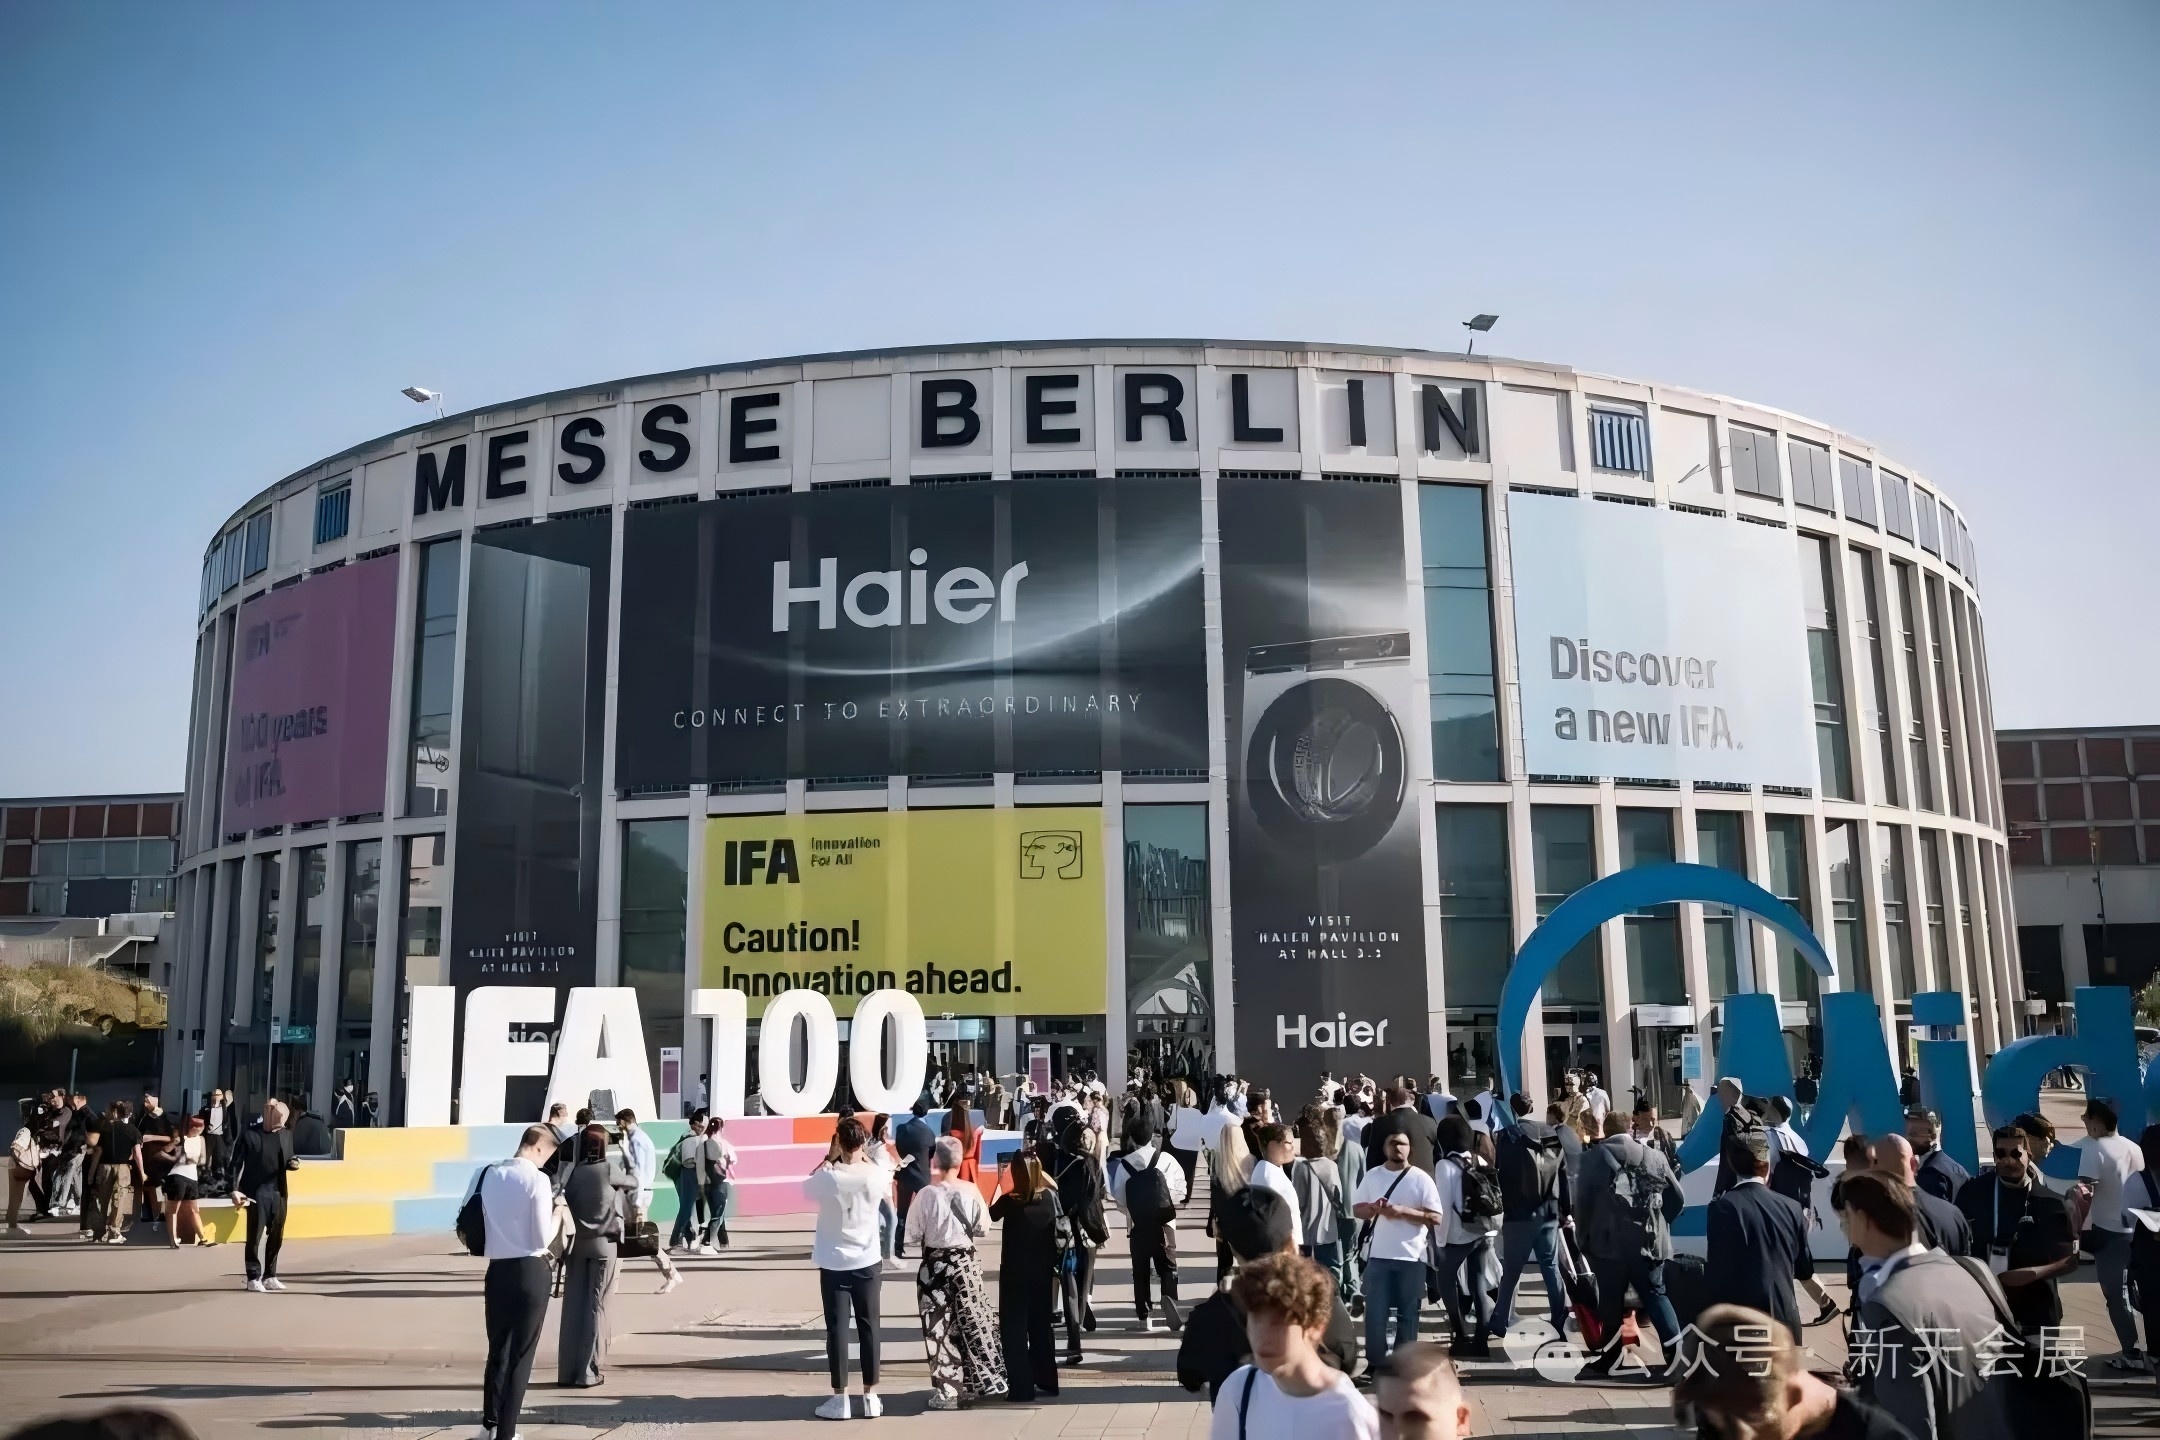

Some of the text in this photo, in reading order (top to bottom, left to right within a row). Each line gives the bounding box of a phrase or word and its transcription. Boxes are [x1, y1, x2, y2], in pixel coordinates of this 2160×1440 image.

[414, 373, 1480, 515] MESSE BERLIN
[772, 548, 1029, 633] Haier
[1550, 635, 1718, 688] Discover
[674, 692, 1142, 729] CONNECT TO EXTRAORDINARY
[1555, 705, 1744, 751] a new IFA.
[724, 839, 801, 886] IFA
[723, 919, 860, 954] Caution!
[1308, 915, 1351, 927] VISIT
[1307, 948, 1348, 960] HALL
[723, 961, 1022, 997] Innovation ahead.
[1276, 1012, 1389, 1049] Haier
[406, 985, 927, 1127] IFA 100
